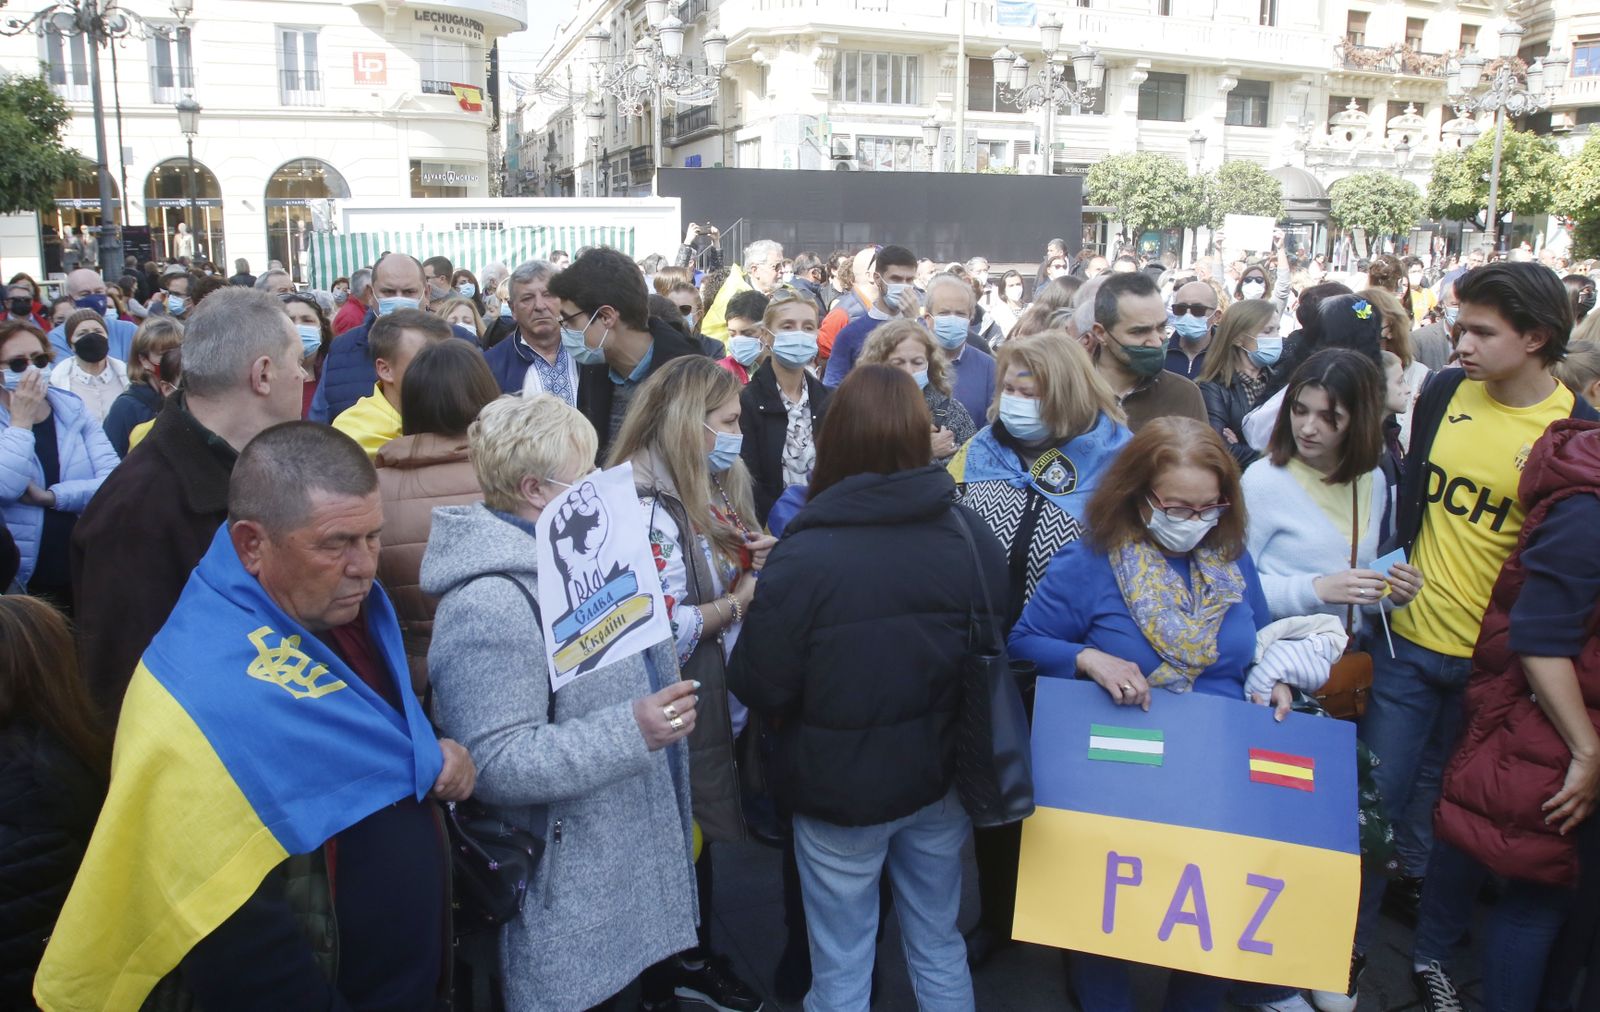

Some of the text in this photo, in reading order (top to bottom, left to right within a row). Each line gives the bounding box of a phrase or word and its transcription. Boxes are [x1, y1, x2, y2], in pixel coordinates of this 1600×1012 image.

[434, 25, 481, 39] ABOGADOS
[423, 173, 447, 182] ALVARO
[1102, 851, 1285, 956] PAZ
